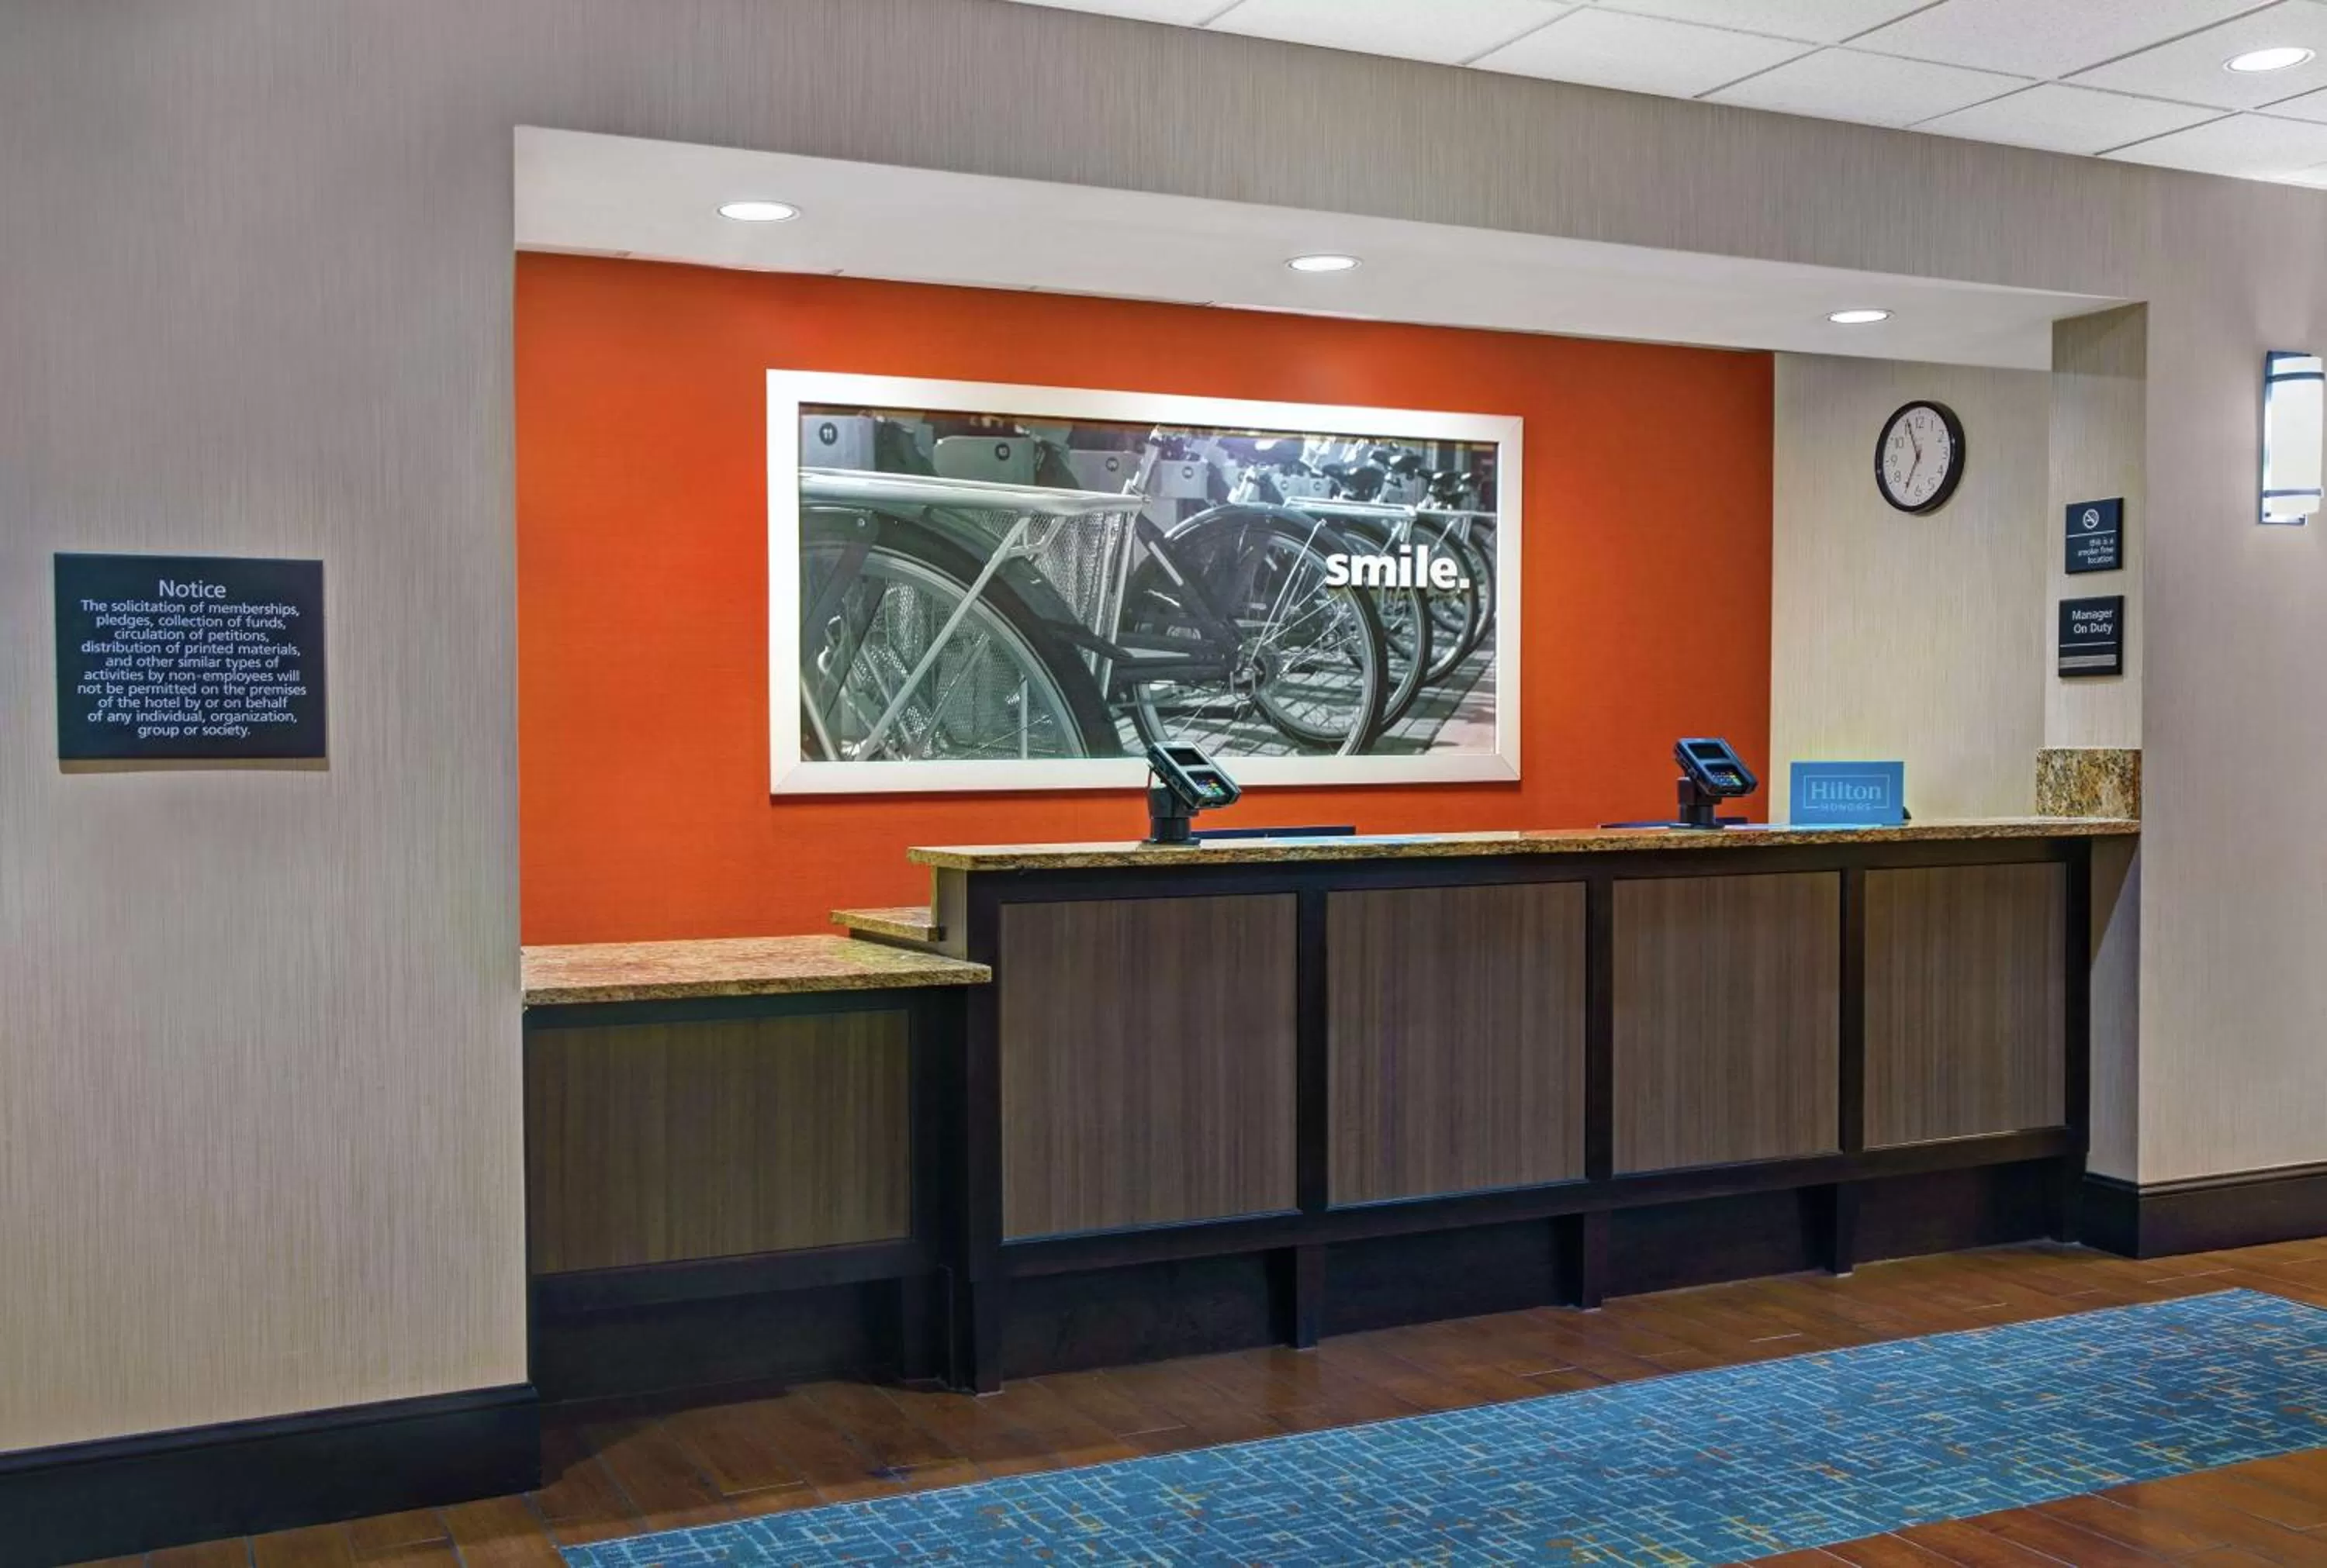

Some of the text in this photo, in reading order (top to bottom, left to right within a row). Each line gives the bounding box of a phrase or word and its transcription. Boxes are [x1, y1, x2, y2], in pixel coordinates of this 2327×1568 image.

[823, 427, 833, 439] 11
[1326, 544, 1471, 589] smile.
[158, 579, 226, 598] Notice
[81, 599, 300, 617] The solicitation of memberships,
[2072, 610, 2113, 621] Manager
[95, 613, 286, 630] pledges, collection of funds,
[2073, 623, 2113, 635] On Duty
[114, 628, 269, 643] circulation of petitions,
[81, 641, 300, 658] distribution of printed materials,
[105, 654, 279, 670] and other similar types of
[83, 668, 301, 685] activities by non-employees will
[77, 682, 307, 697] not be permitted on the premises
[98, 696, 289, 711] of the hotel by or on behalf
[87, 710, 298, 726] of any individual, organization,
[137, 723, 251, 739] group or society.
[1811, 781, 1882, 800] Hilton
